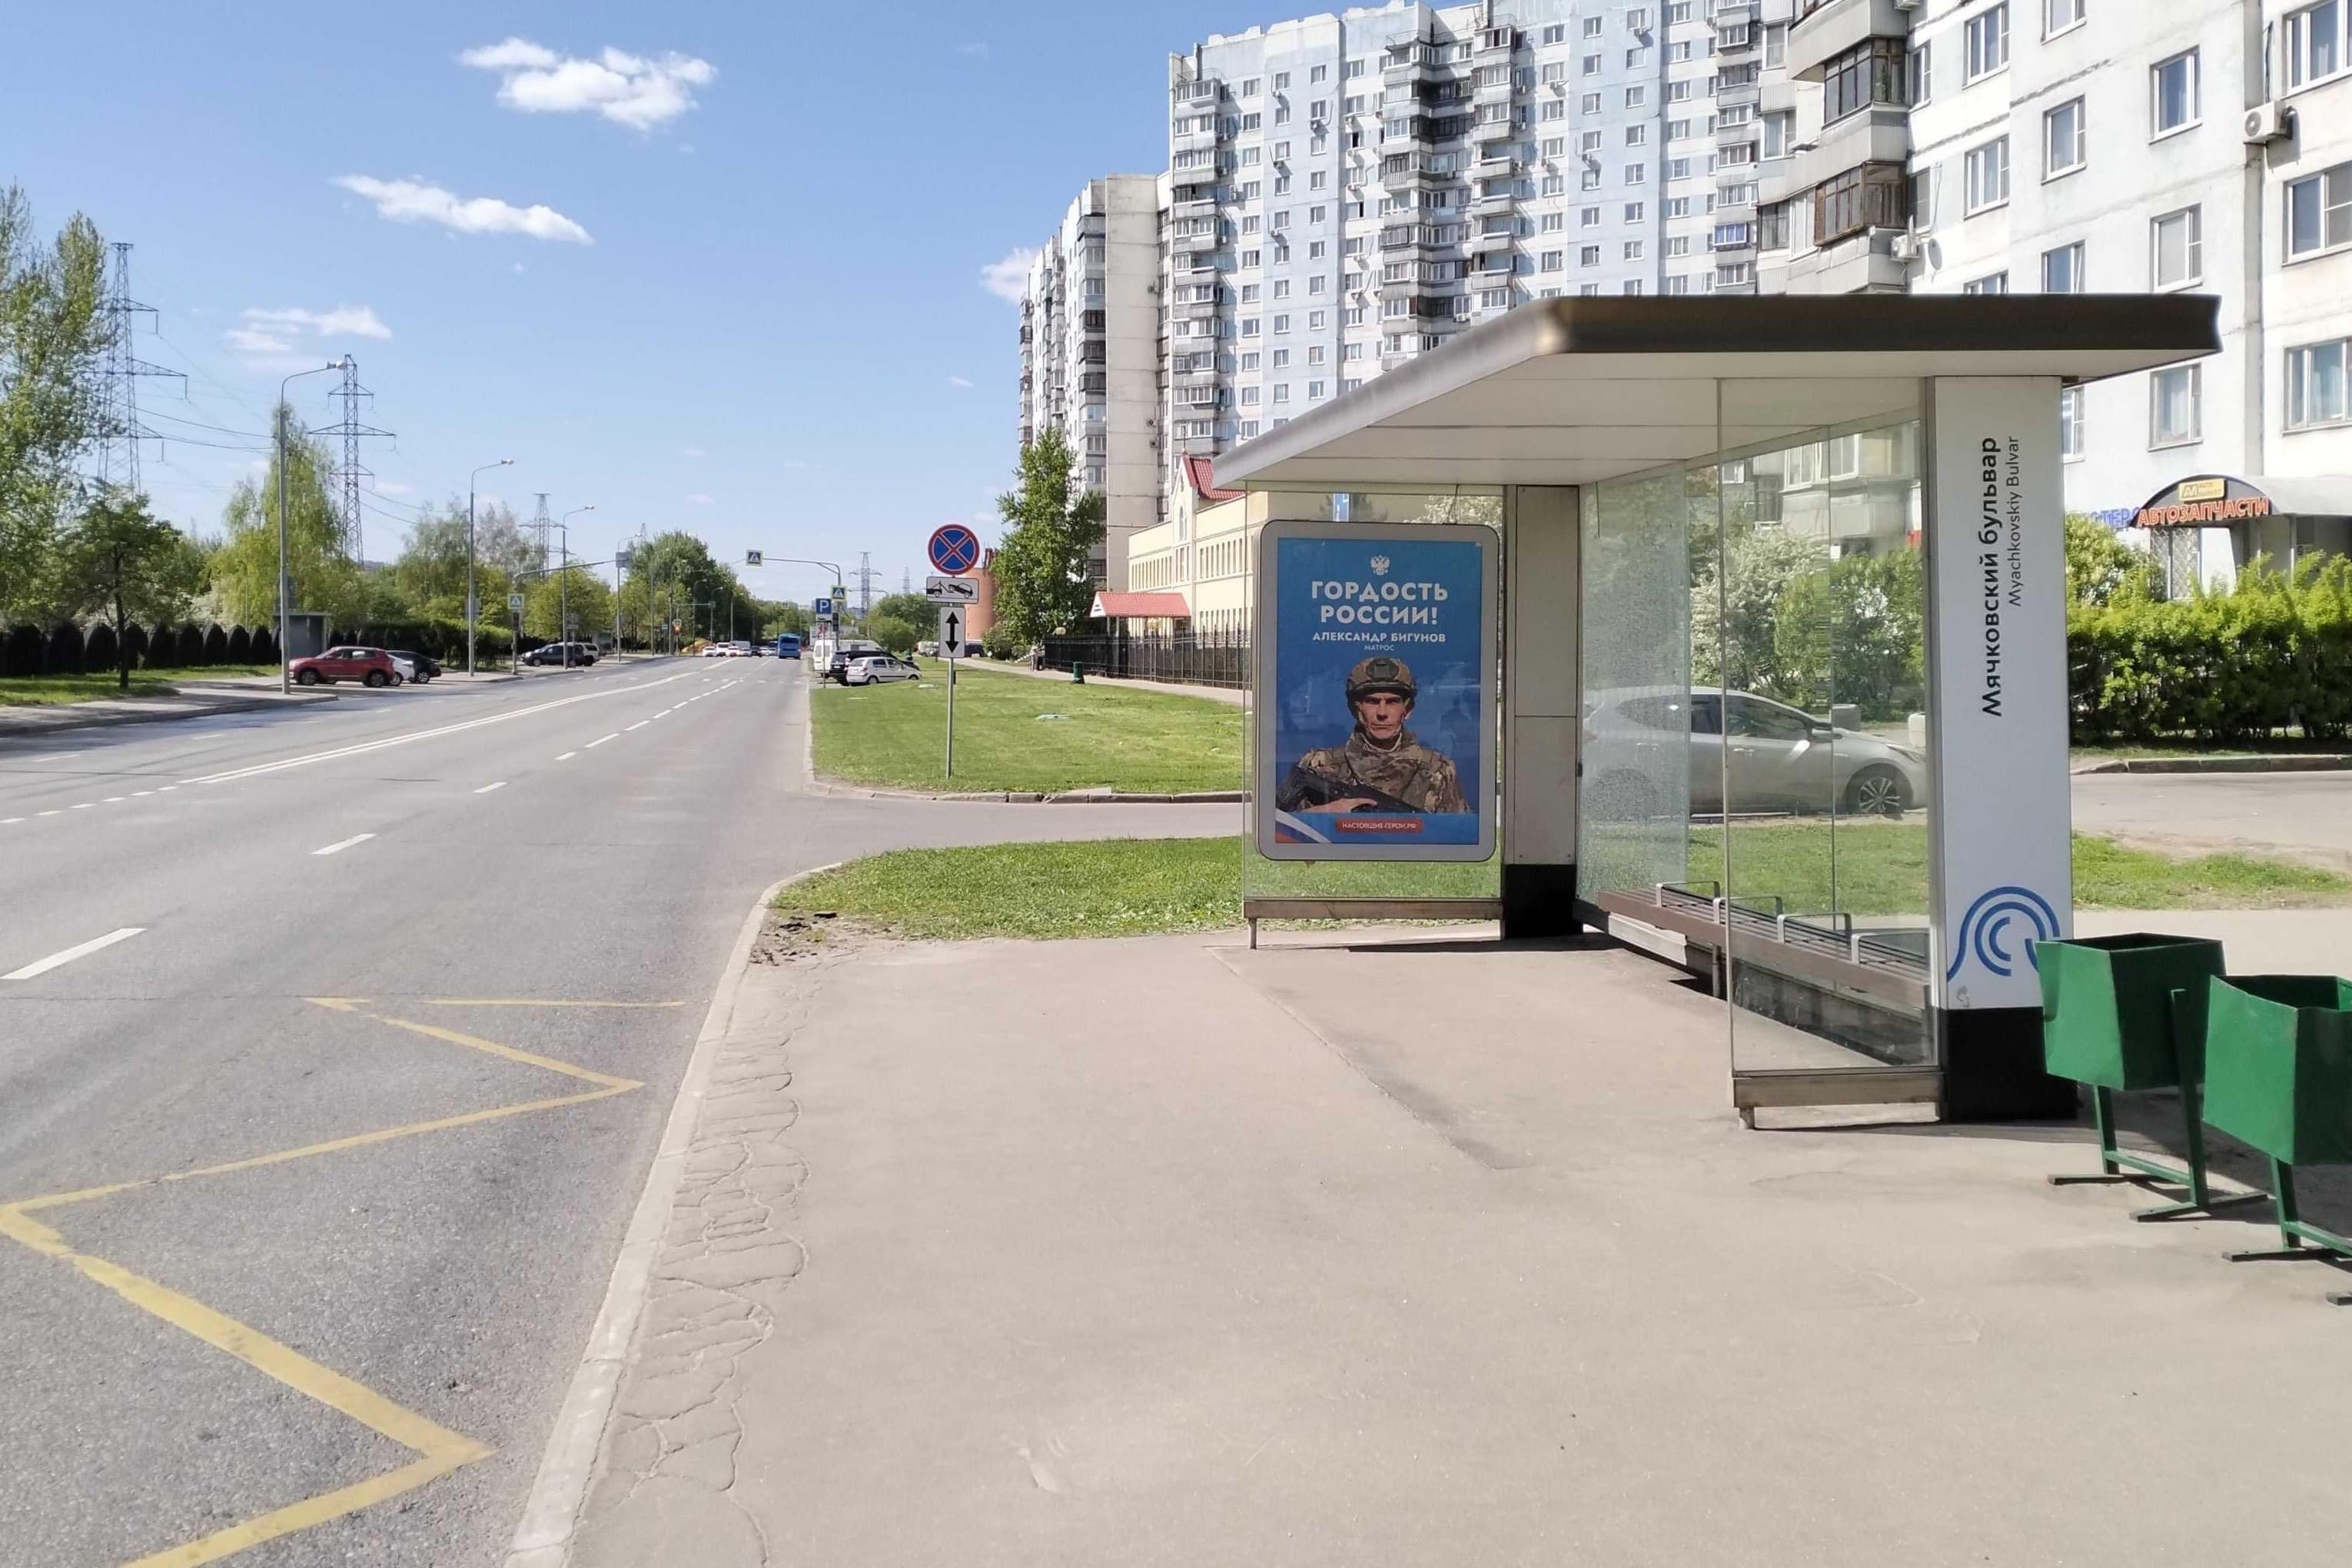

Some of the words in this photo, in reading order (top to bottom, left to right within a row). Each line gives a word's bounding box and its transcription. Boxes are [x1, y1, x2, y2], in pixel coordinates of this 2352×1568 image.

[2005, 436, 2021, 487] Bulvar
[1978, 437, 2003, 545] бульвар
[2137, 496, 2270, 527] АВТОЗАПЧАСТИ
[2006, 491, 2024, 607] Myachkovskiy
[1311, 580, 1449, 603] ГОРДОСТЬ
[1320, 604, 1439, 625] РОССИИ!
[1978, 553, 2002, 717] Мячковский
[1312, 631, 1387, 643] АЛЕКСАНДР
[1390, 633, 1447, 643] БИГУНОВ
